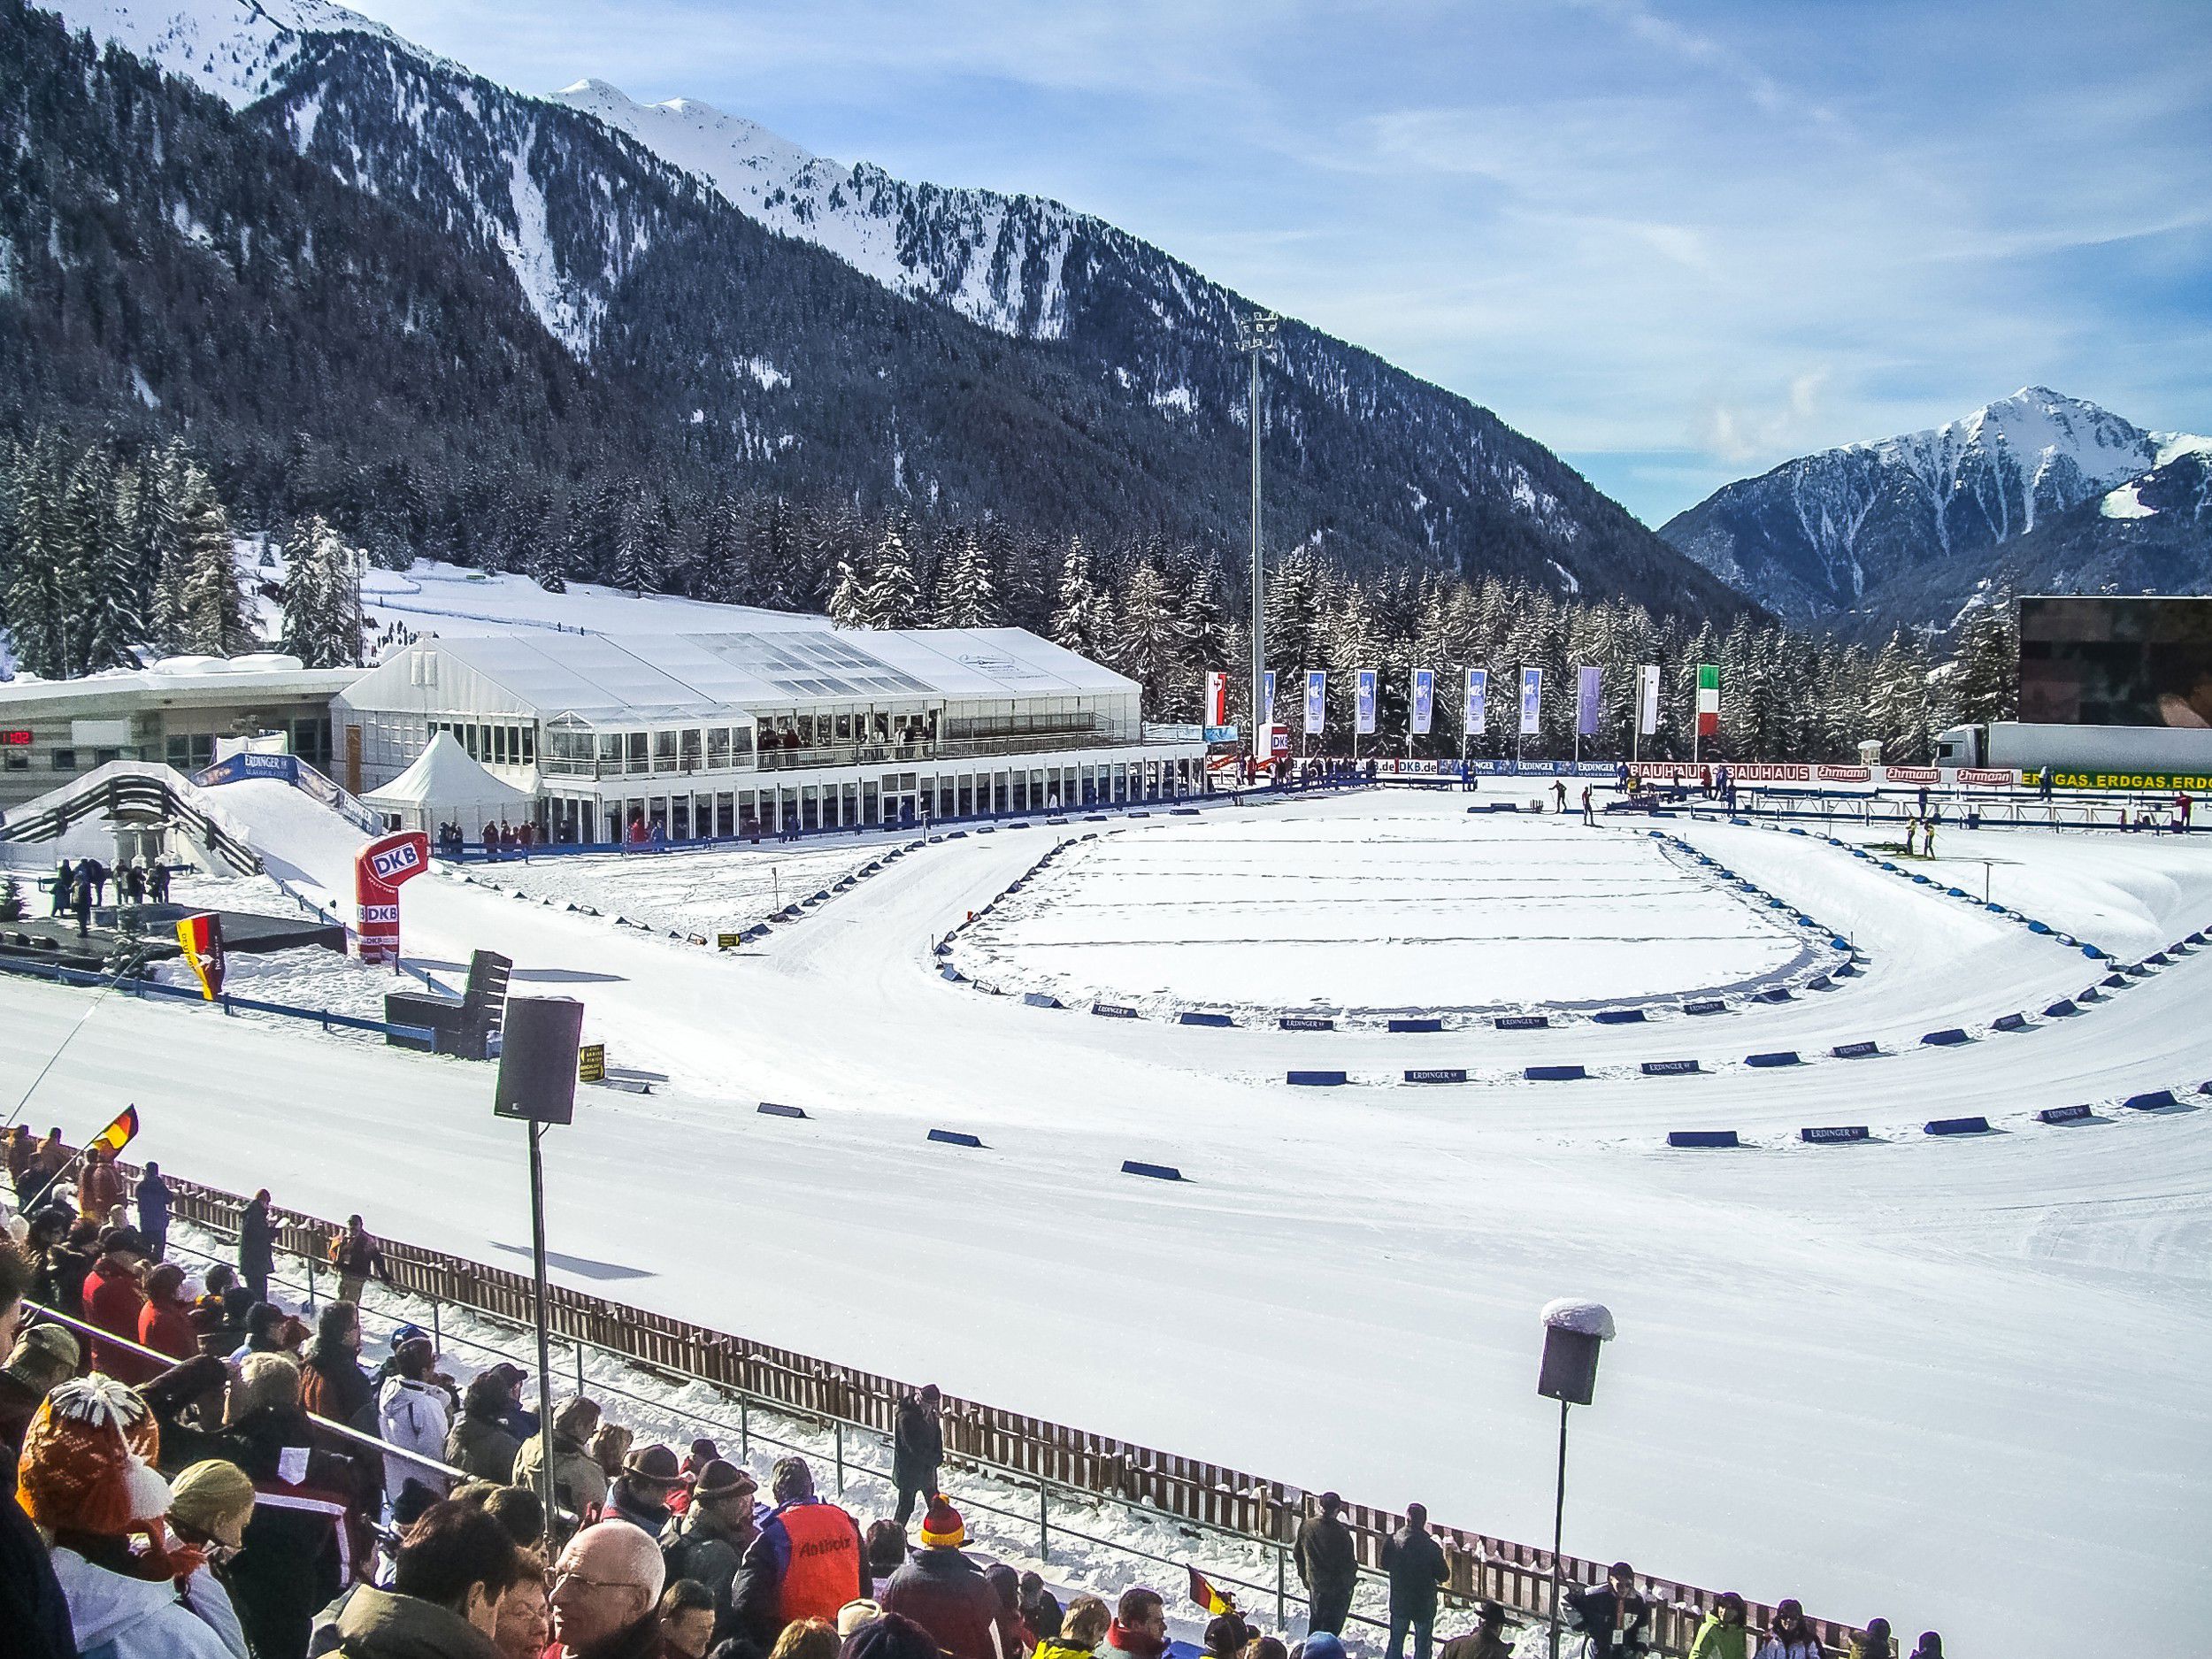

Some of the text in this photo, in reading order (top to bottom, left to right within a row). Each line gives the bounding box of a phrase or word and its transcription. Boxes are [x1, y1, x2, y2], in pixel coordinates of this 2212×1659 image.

[245, 755, 280, 769] ERDINGER
[1374, 762, 1394, 772] B.de
[1399, 762, 1437, 772] DKB.de
[1517, 761, 1555, 771] ERDINGER
[1578, 762, 1615, 772] ERDINGER
[1726, 766, 1809, 780] BAUHAUS
[1818, 766, 1867, 780] Ehrmann
[1886, 767, 1938, 780] Ehrmann
[1957, 769, 2010, 783] Ehrmann
[374, 847, 417, 874] DKB
[368, 908, 397, 920] DKB
[1811, 1128, 1851, 1137] ERDINGER
